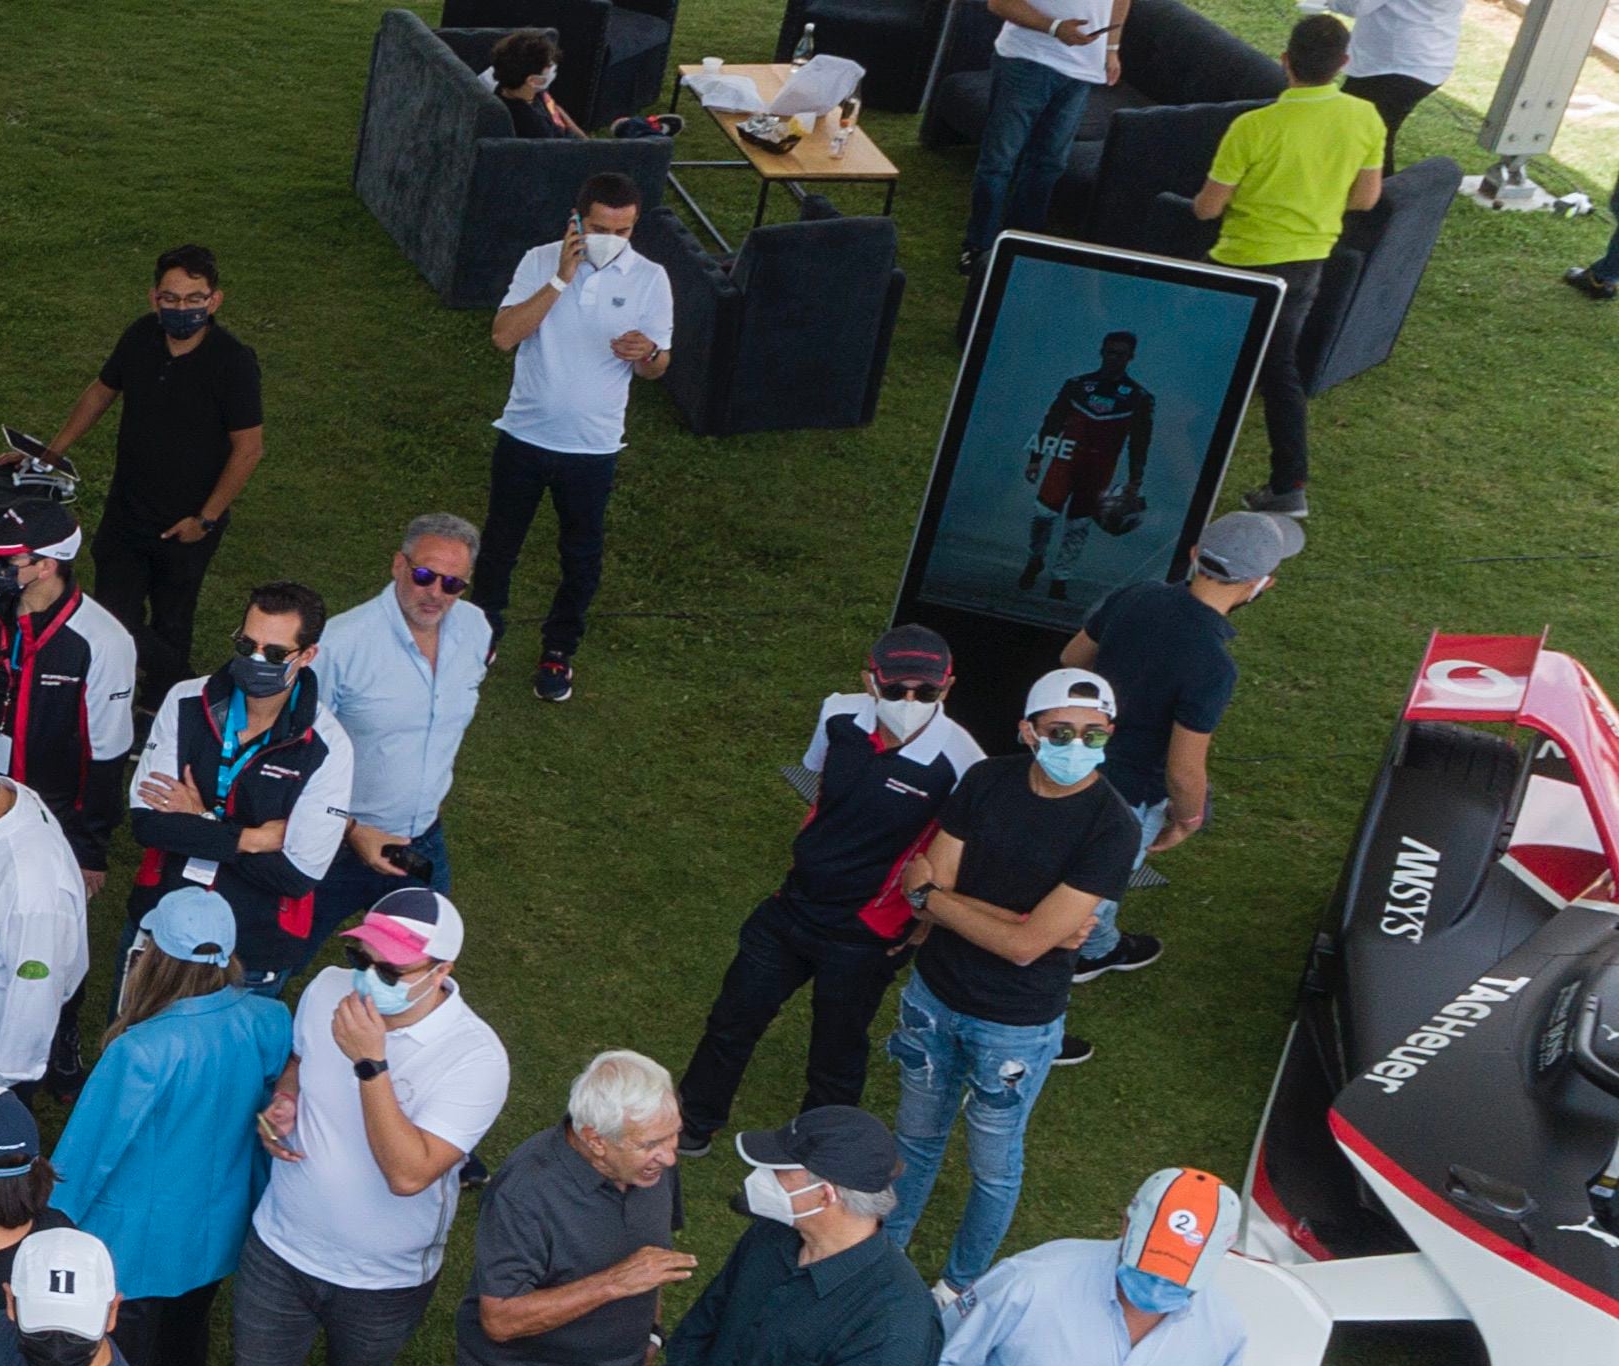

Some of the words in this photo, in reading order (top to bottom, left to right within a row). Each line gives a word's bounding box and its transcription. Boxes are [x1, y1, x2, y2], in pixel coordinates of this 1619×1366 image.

[1381, 836, 1442, 944] ANSYS
[1178, 1213, 1193, 1232] 2
[54, 1270, 68, 1294] 1
